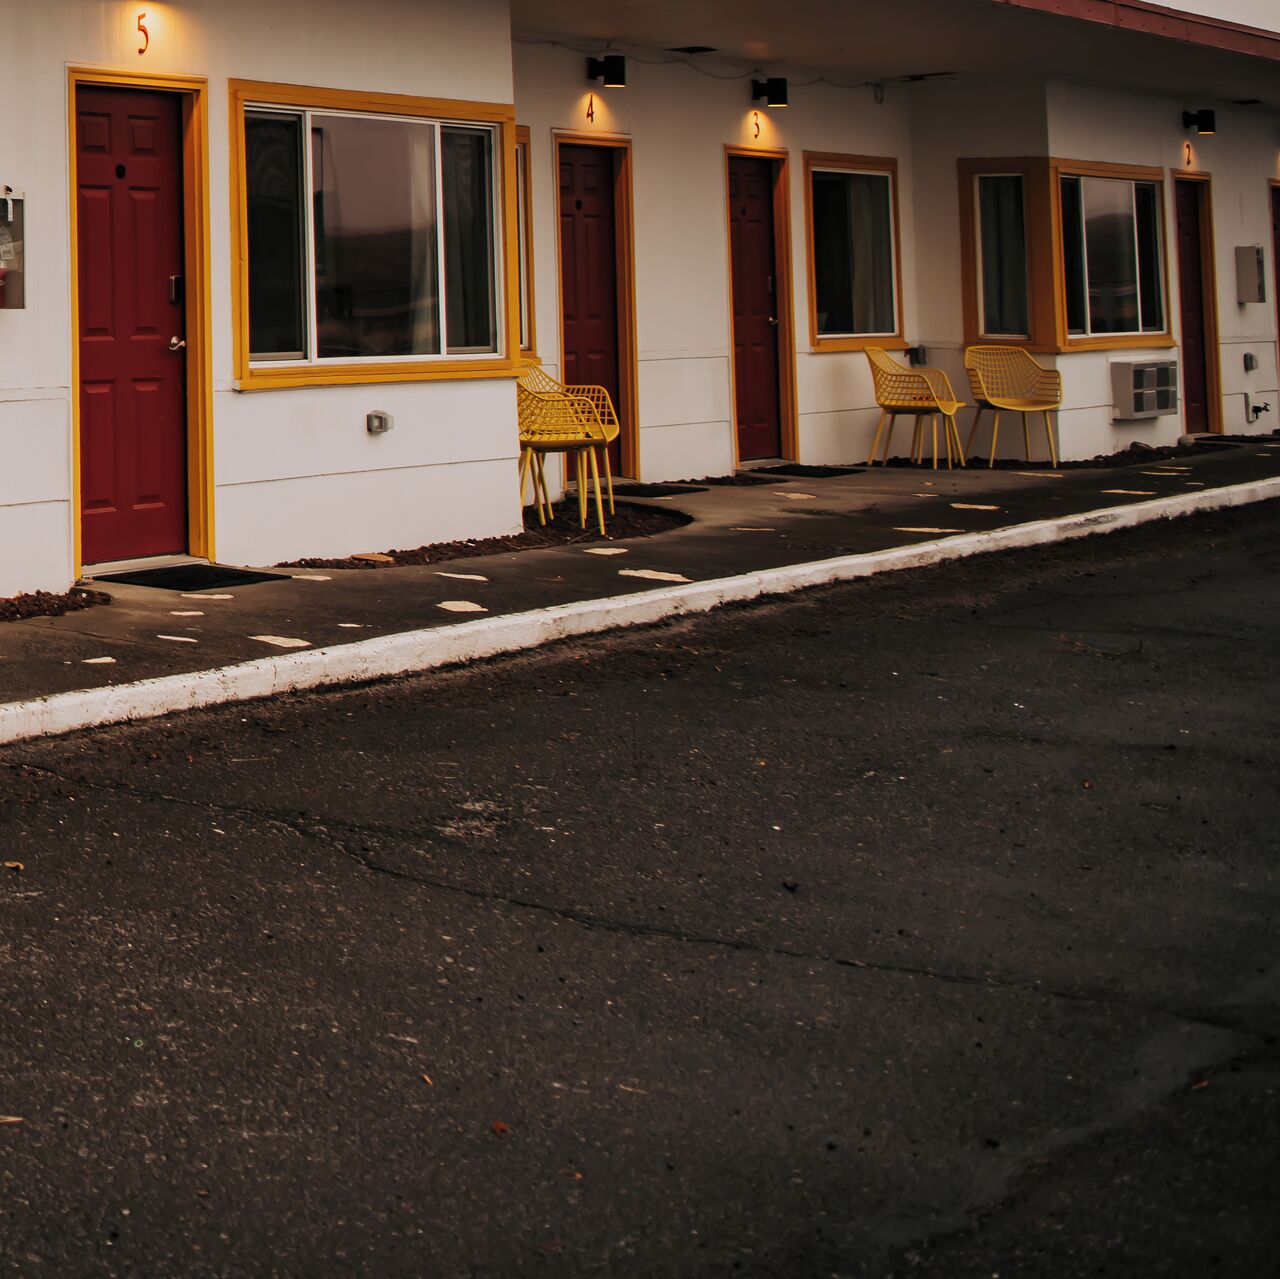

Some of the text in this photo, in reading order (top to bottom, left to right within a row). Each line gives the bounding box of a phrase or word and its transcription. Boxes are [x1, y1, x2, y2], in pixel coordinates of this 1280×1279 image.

[138, 12, 148, 55] 5
[586, 94, 594, 123] 4
[754, 111, 760, 139] 3
